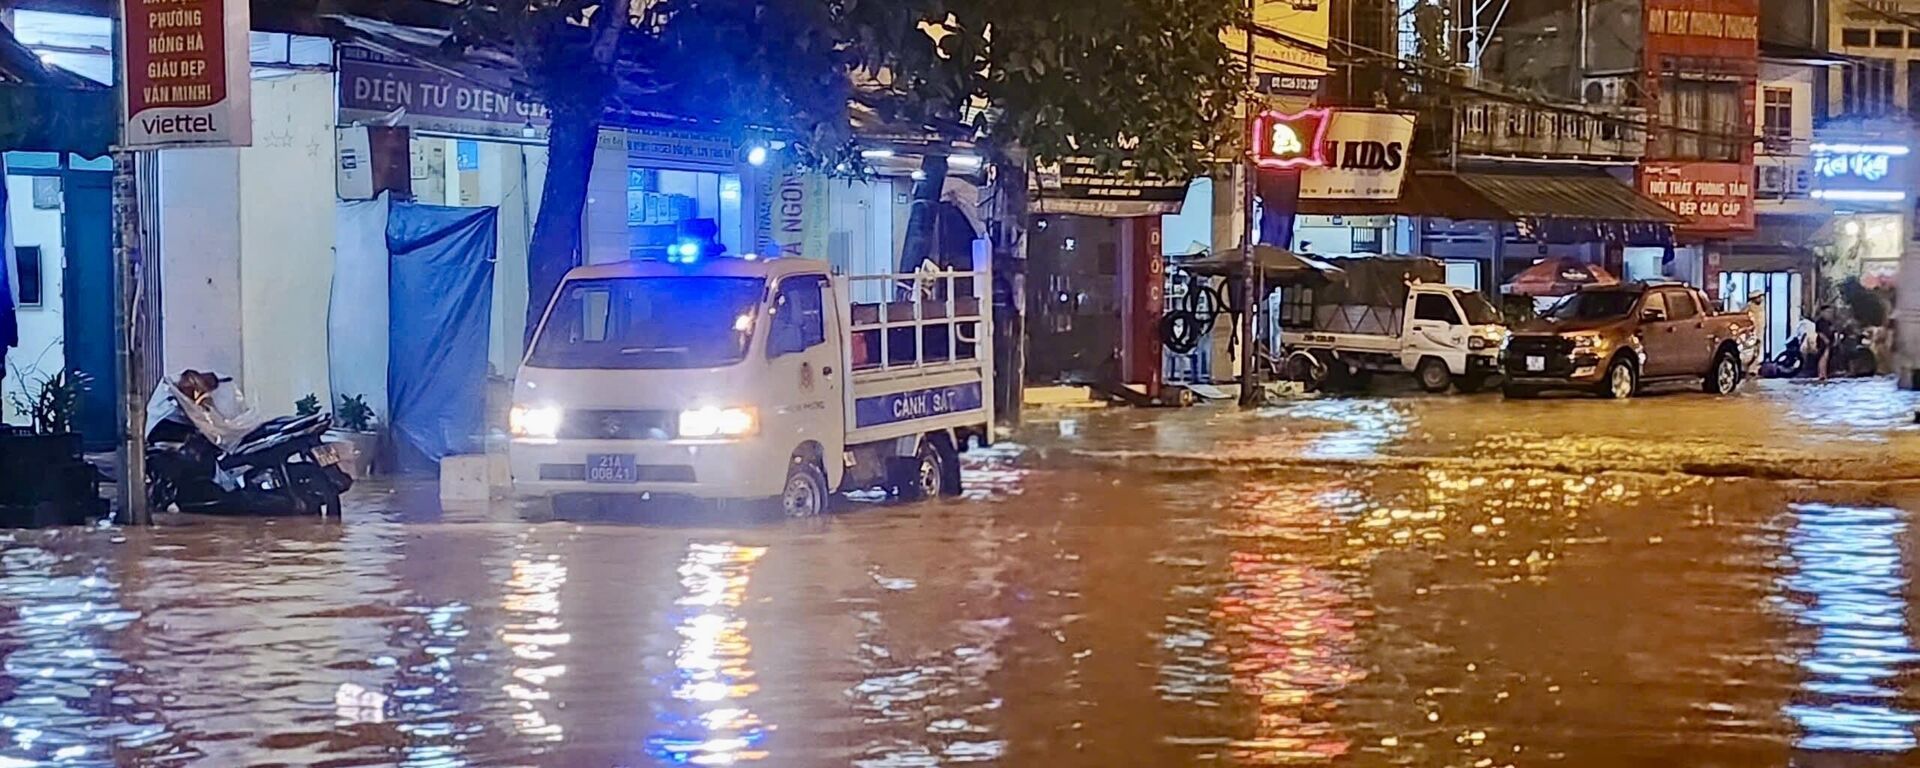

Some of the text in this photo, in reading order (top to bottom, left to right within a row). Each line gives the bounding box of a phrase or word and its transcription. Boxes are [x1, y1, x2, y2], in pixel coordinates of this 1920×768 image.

[149, 7, 202, 29] PHƯỜNG
[187, 32, 204, 52] HÀ
[181, 60, 206, 79] ĐẸP
[172, 84, 212, 102] MINH!
[354, 72, 412, 108] ĐIỆN
[419, 77, 452, 108] TỬ
[141, 113, 217, 135] viettel
[1341, 141, 1402, 171] KIDS
[1650, 178, 1667, 197] NỘI
[1669, 177, 1692, 195] THẤT
[1700, 201, 1719, 216] CAO
[893, 392, 926, 418] CẢNH
[600, 455, 621, 467] 21A
